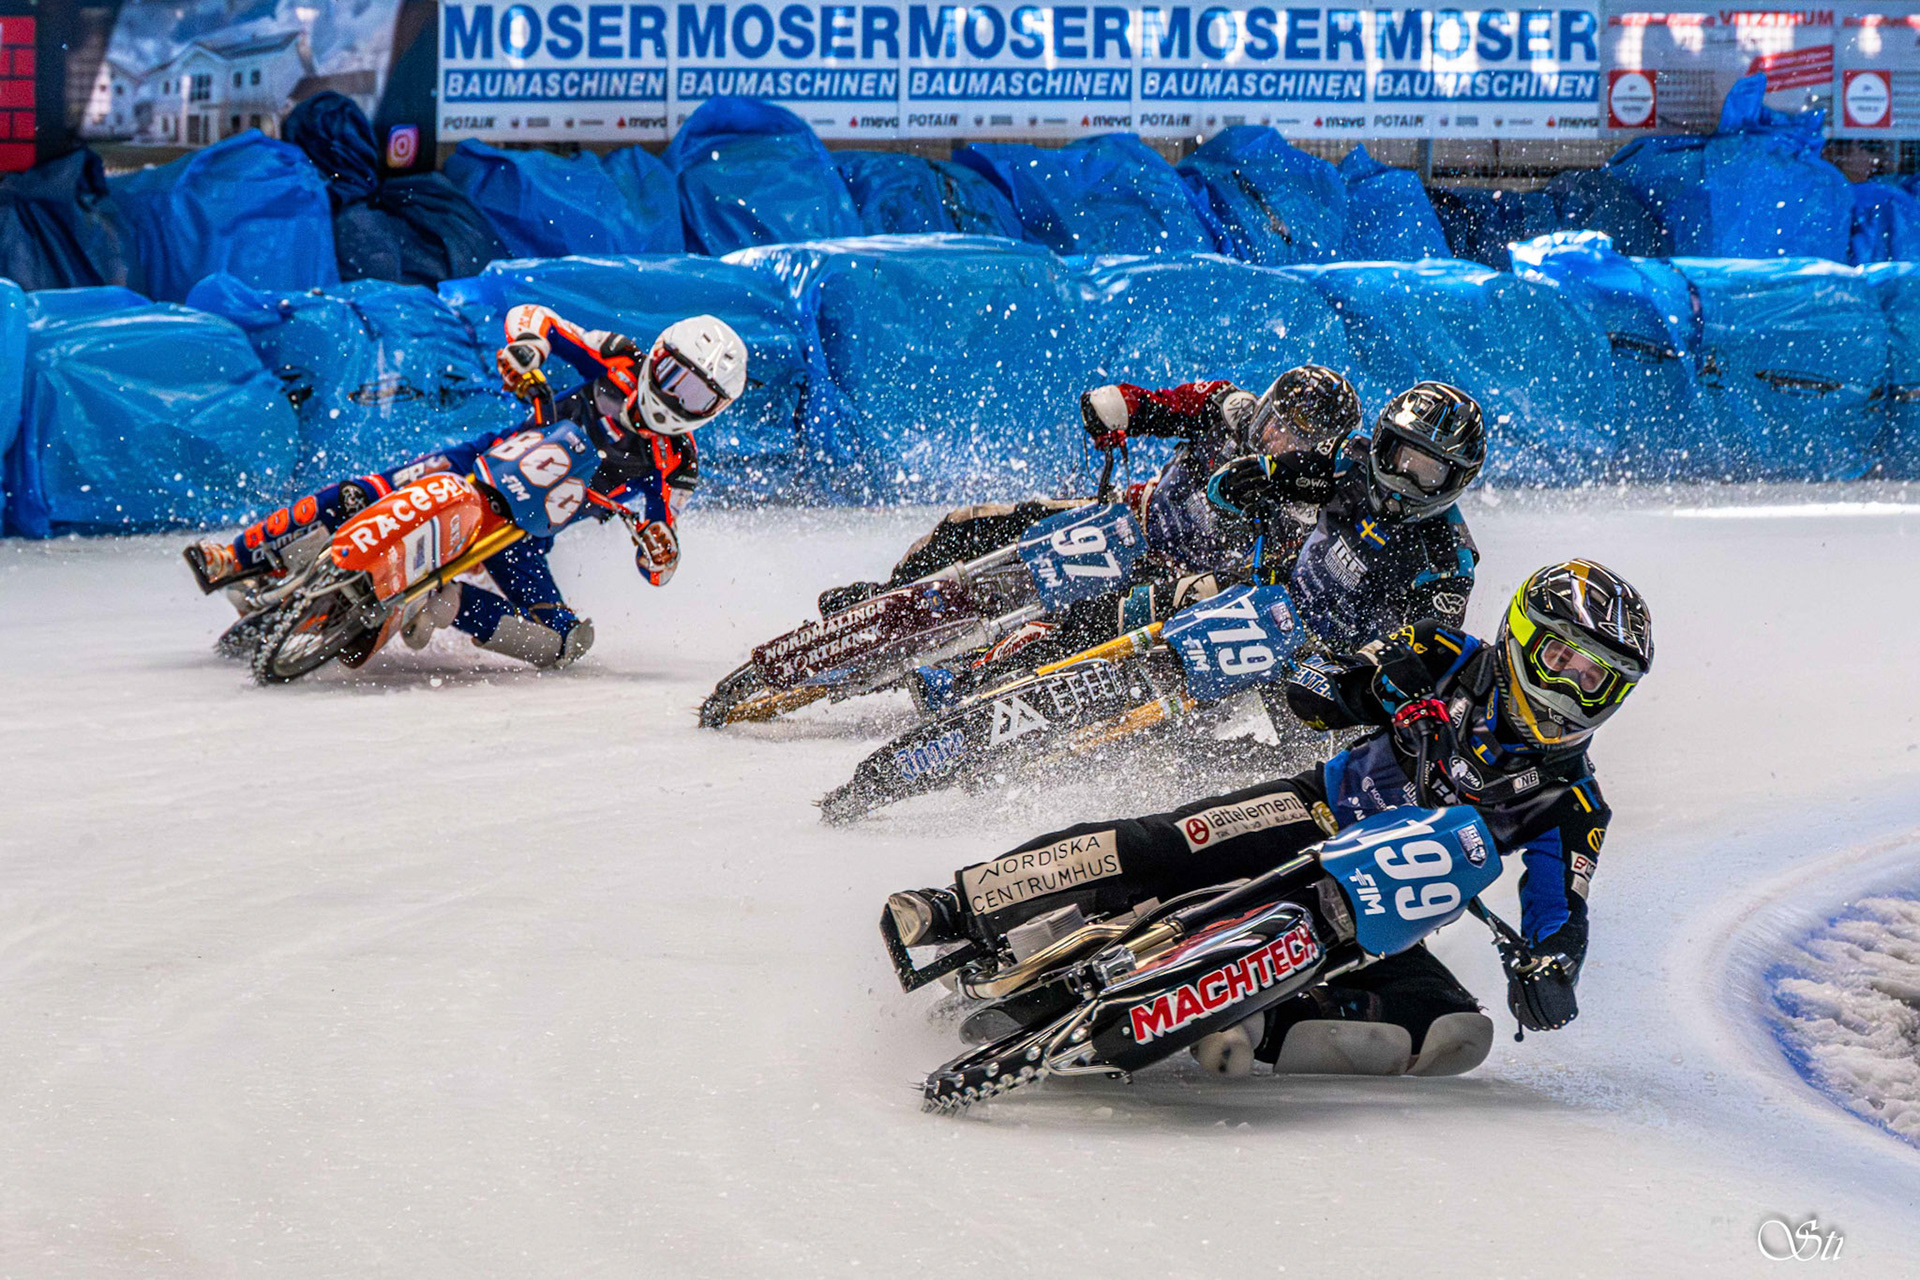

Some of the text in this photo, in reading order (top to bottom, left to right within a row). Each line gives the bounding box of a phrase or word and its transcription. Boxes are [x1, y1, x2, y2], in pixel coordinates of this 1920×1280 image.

[445, 4, 667, 59] MOSER
[677, 4, 899, 59] MOSER
[908, 5, 1132, 59] MOSER
[1142, 6, 1364, 60] MOSER
[1375, 8, 1597, 61] MOSER
[446, 72, 665, 97] BAUMASCHINEN
[679, 72, 898, 97] BAUMASCHINEN
[911, 72, 1129, 96] BAUMASCHINEN
[1143, 73, 1361, 97] BAUMASCHINEN
[1376, 73, 1594, 97] BAUMASCHINEN
[490, 431, 586, 526] 800
[1051, 526, 1121, 578] 97
[1193, 595, 1275, 676] 719
[972, 855, 1117, 913] CENTRUMHUS
[978, 836, 1100, 885] NORDISKA
[1357, 819, 1461, 921] 199
[1349, 868, 1386, 915] FIM
[1129, 922, 1320, 1045] MACHTECH
